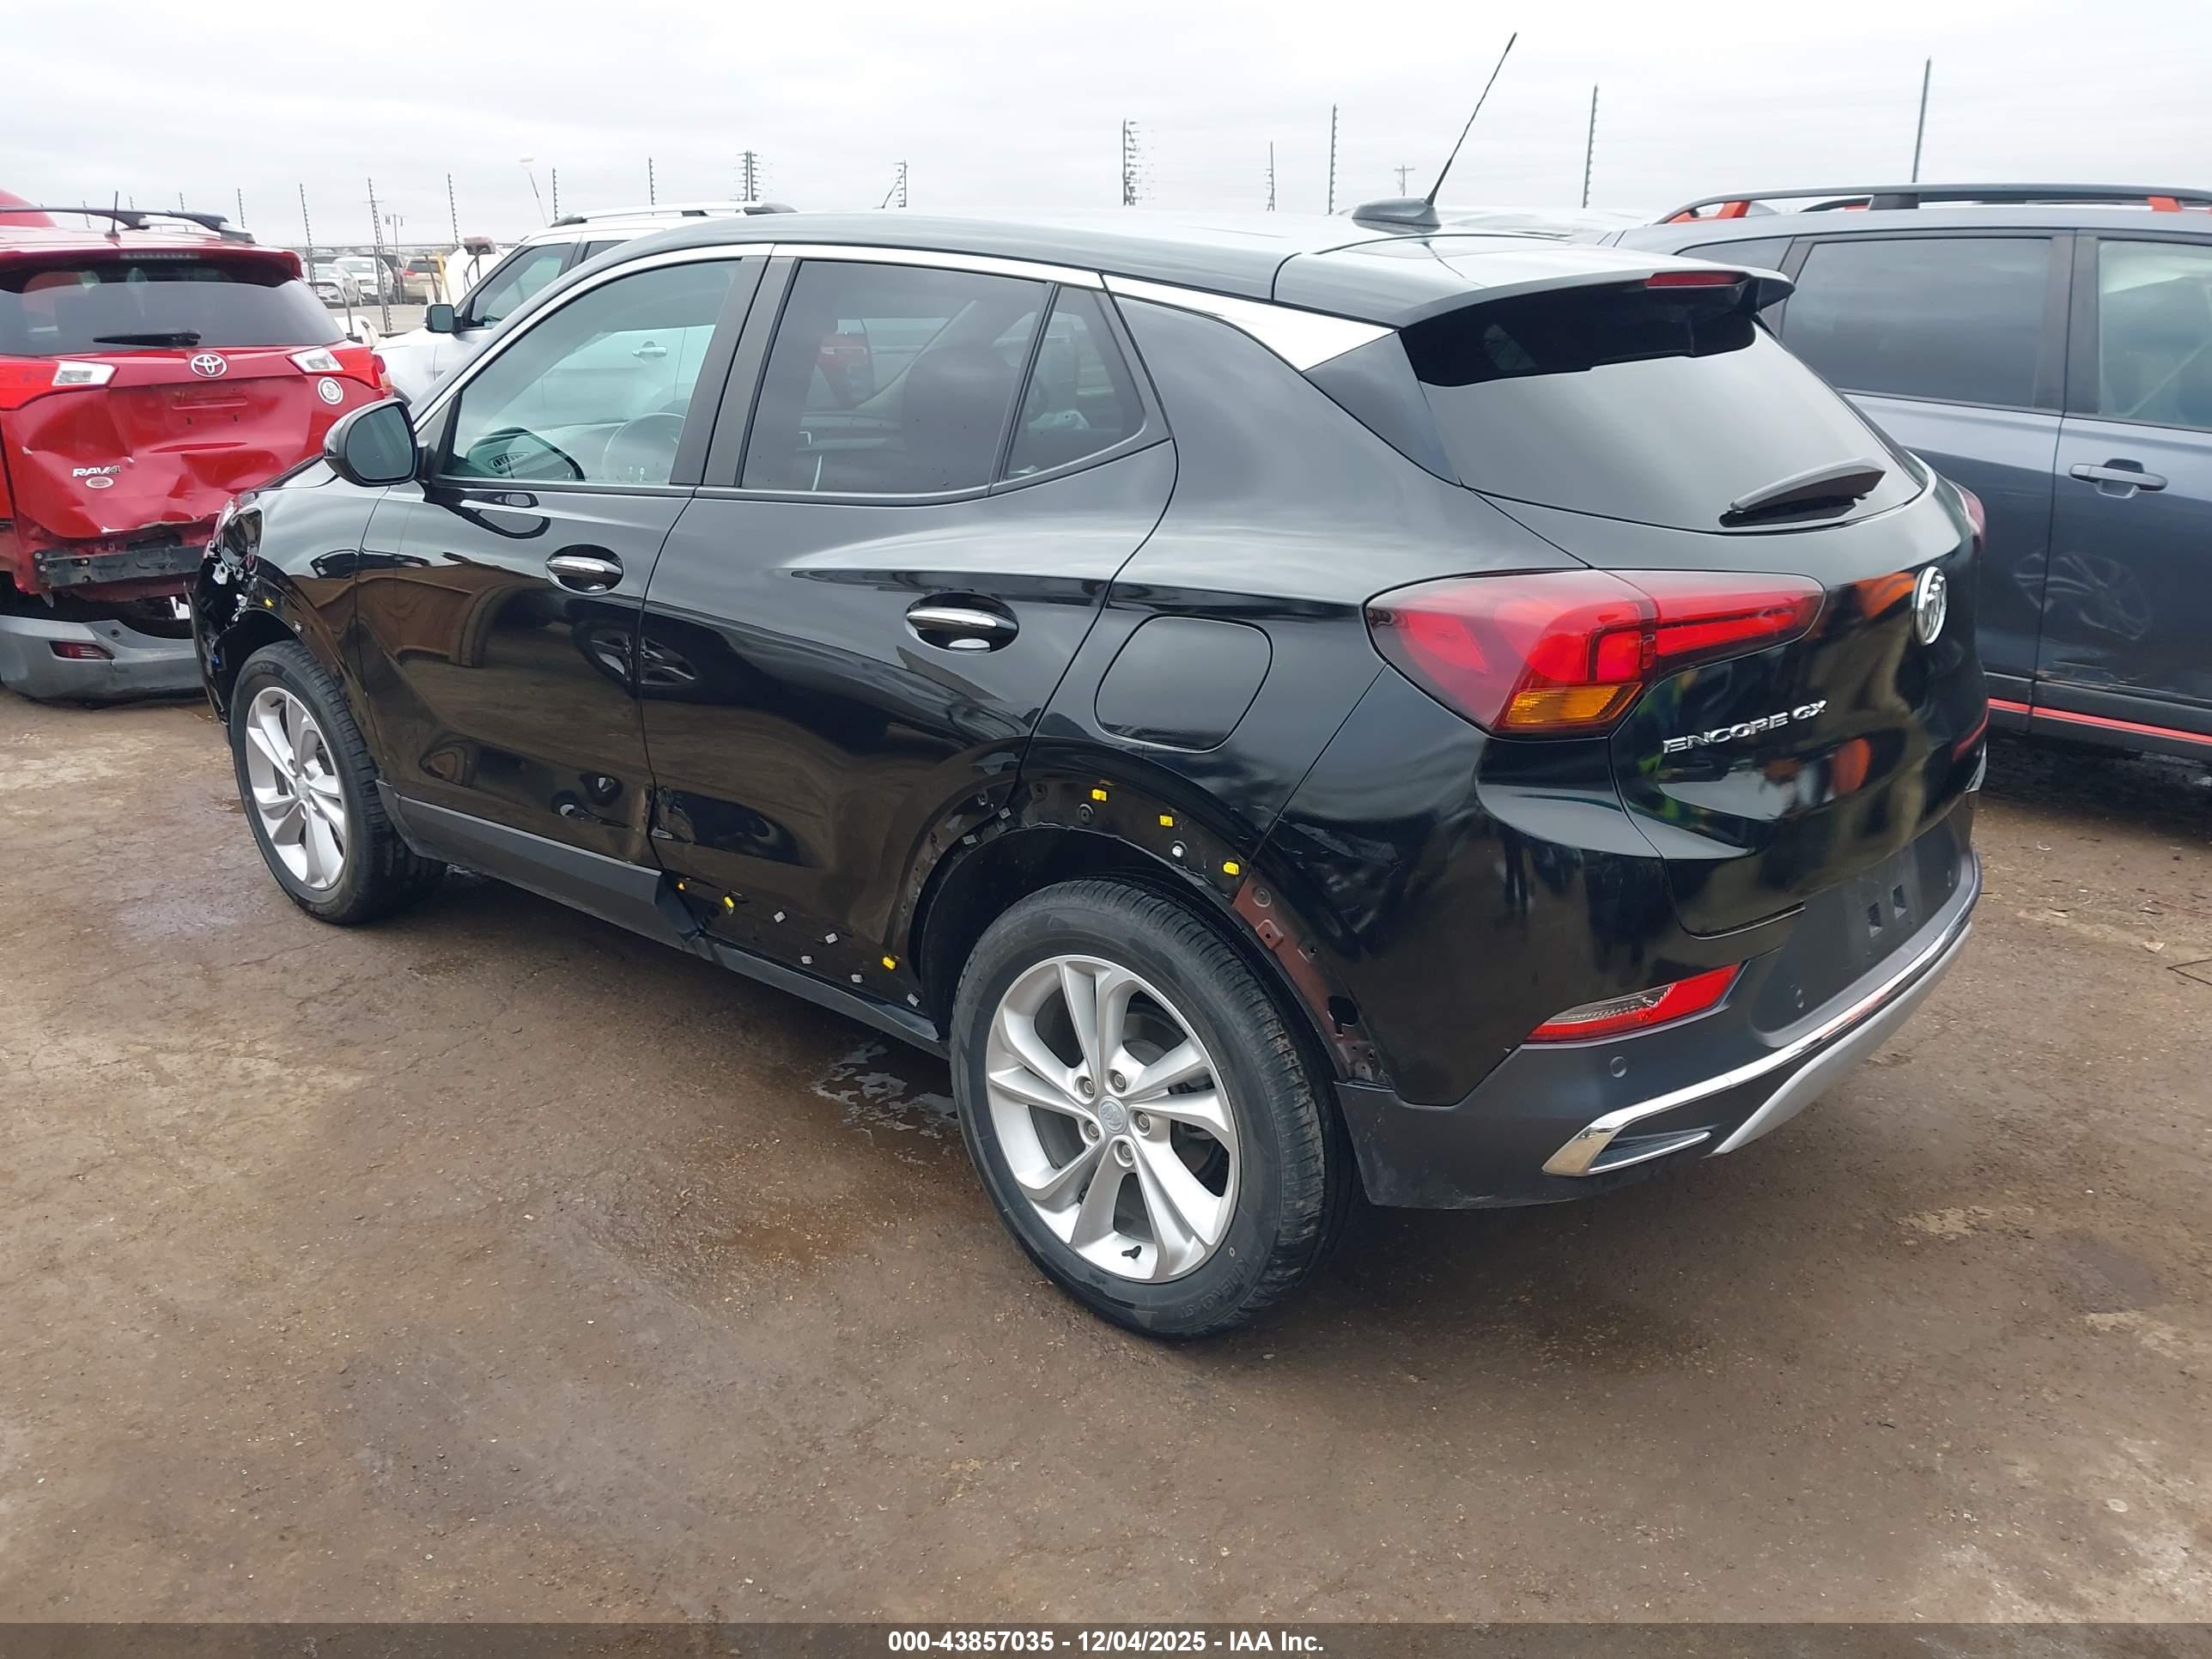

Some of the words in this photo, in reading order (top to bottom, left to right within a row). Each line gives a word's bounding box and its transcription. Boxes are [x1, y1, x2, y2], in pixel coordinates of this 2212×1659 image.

[72, 465, 121, 477] RAV4
[1662, 711, 1790, 754] ENCORE
[1792, 699, 1828, 720] GX
